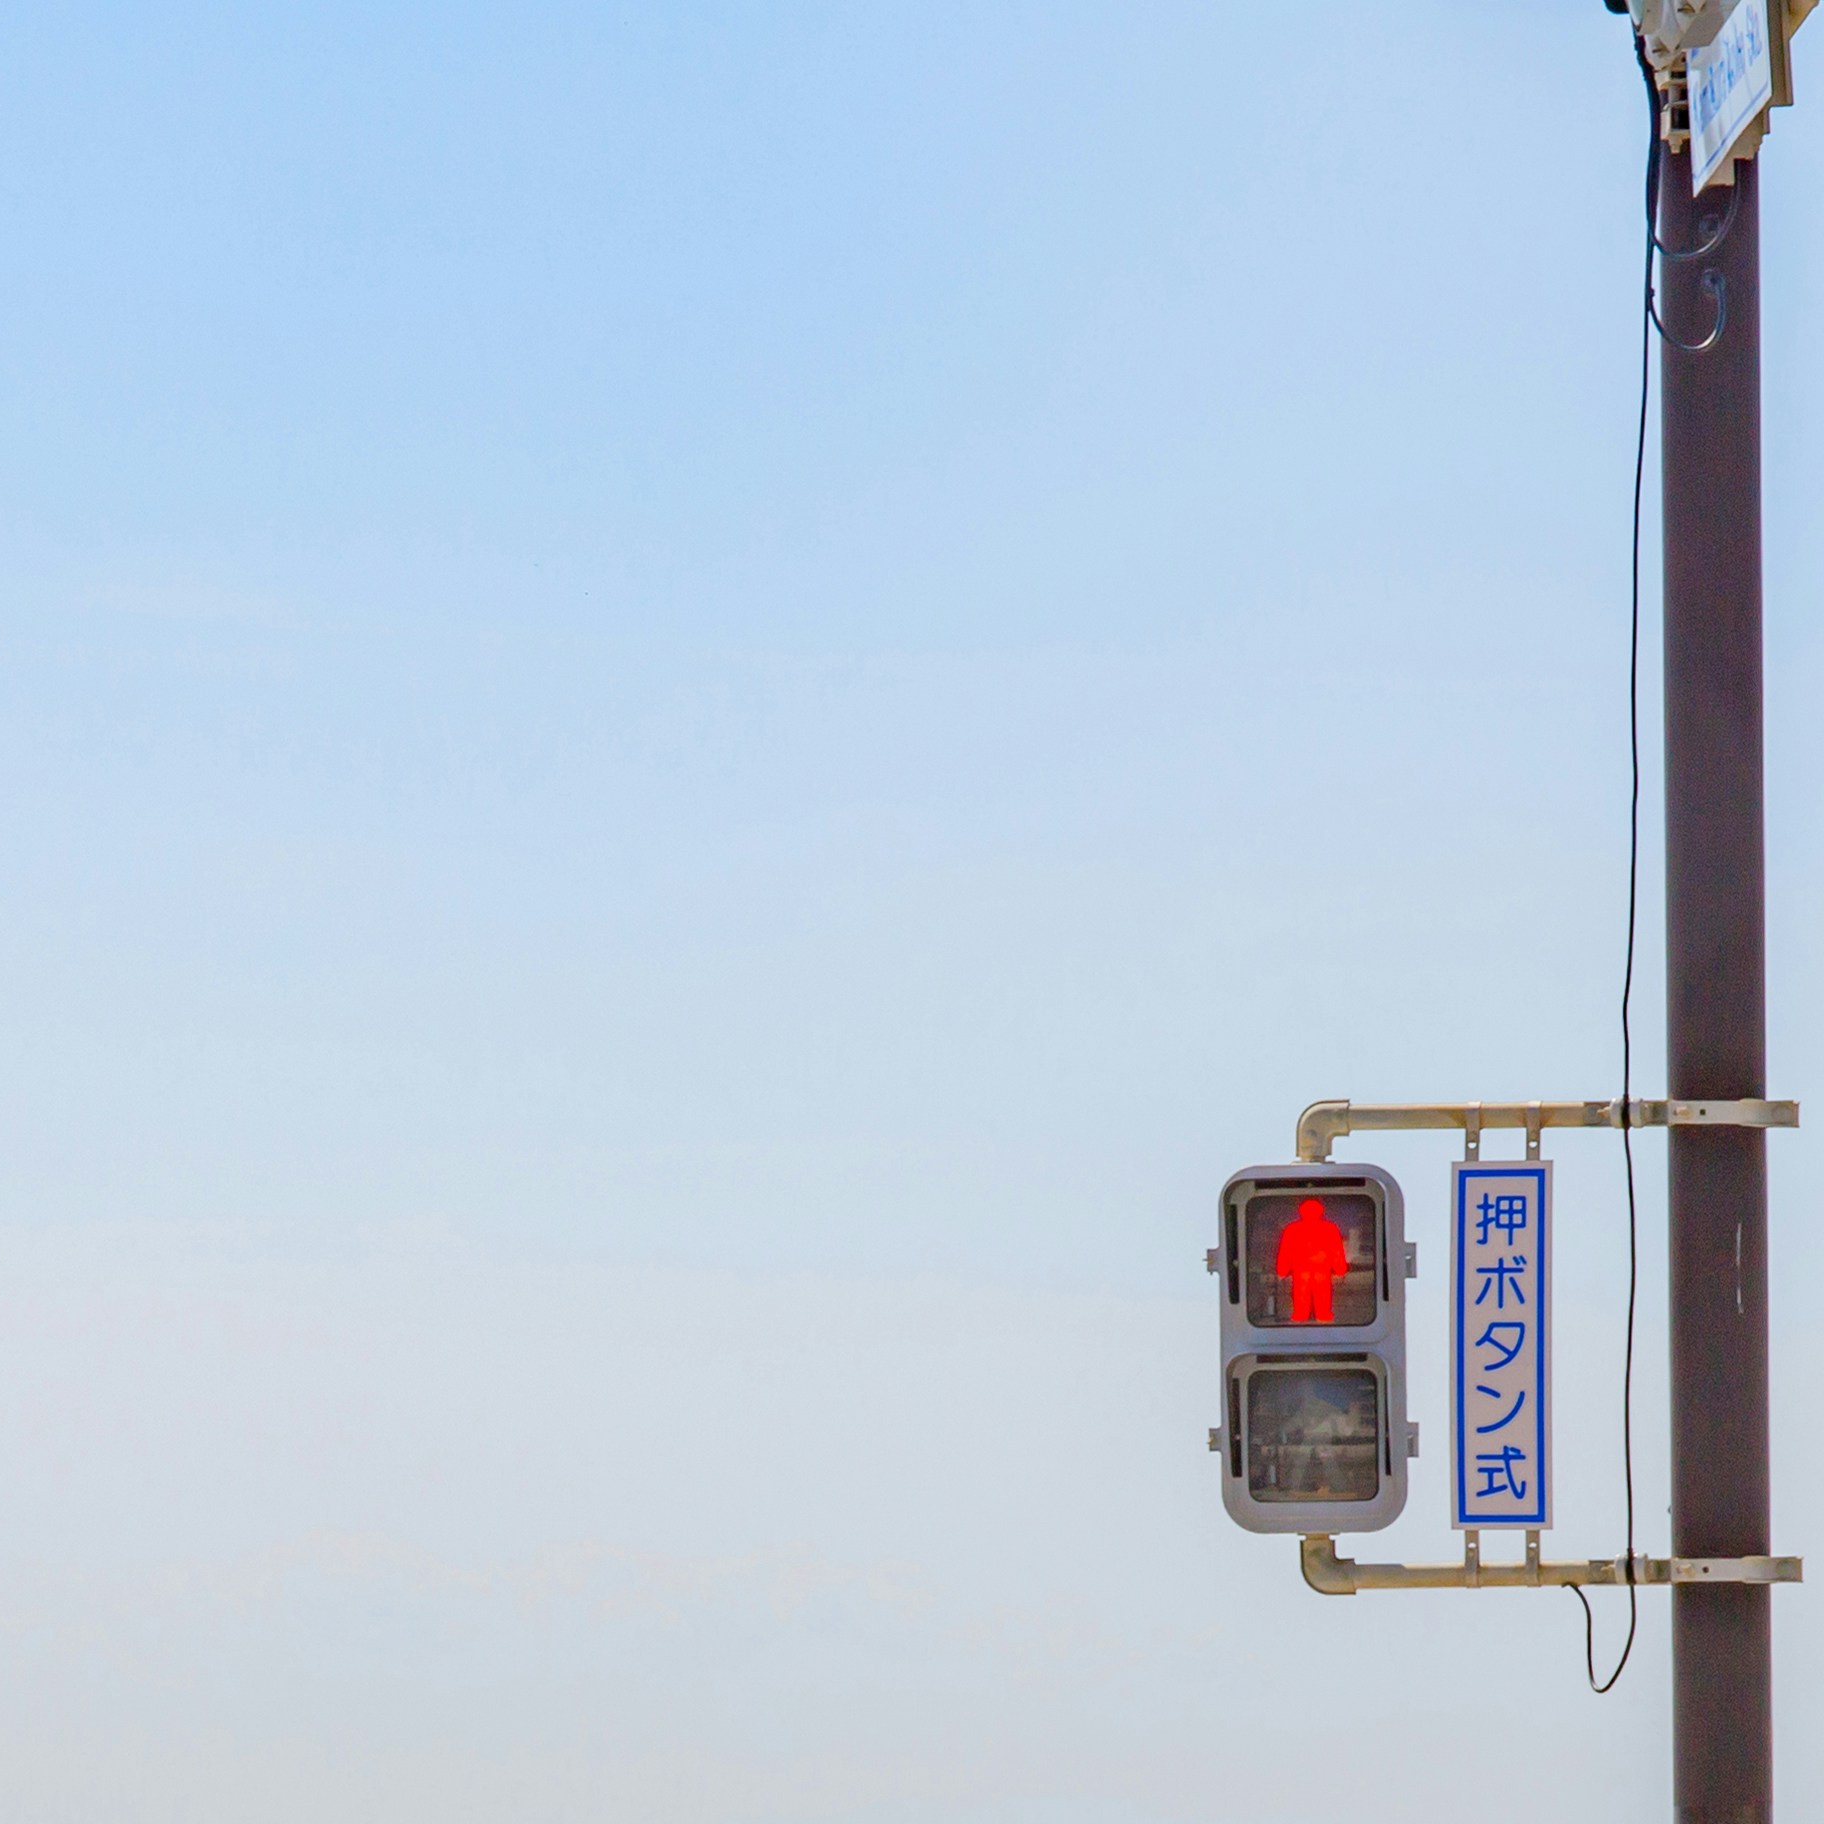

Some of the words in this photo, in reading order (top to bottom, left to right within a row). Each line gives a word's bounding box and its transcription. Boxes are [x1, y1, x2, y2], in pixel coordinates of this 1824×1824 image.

[1475, 1192, 1527, 1500] 押ボタン式
